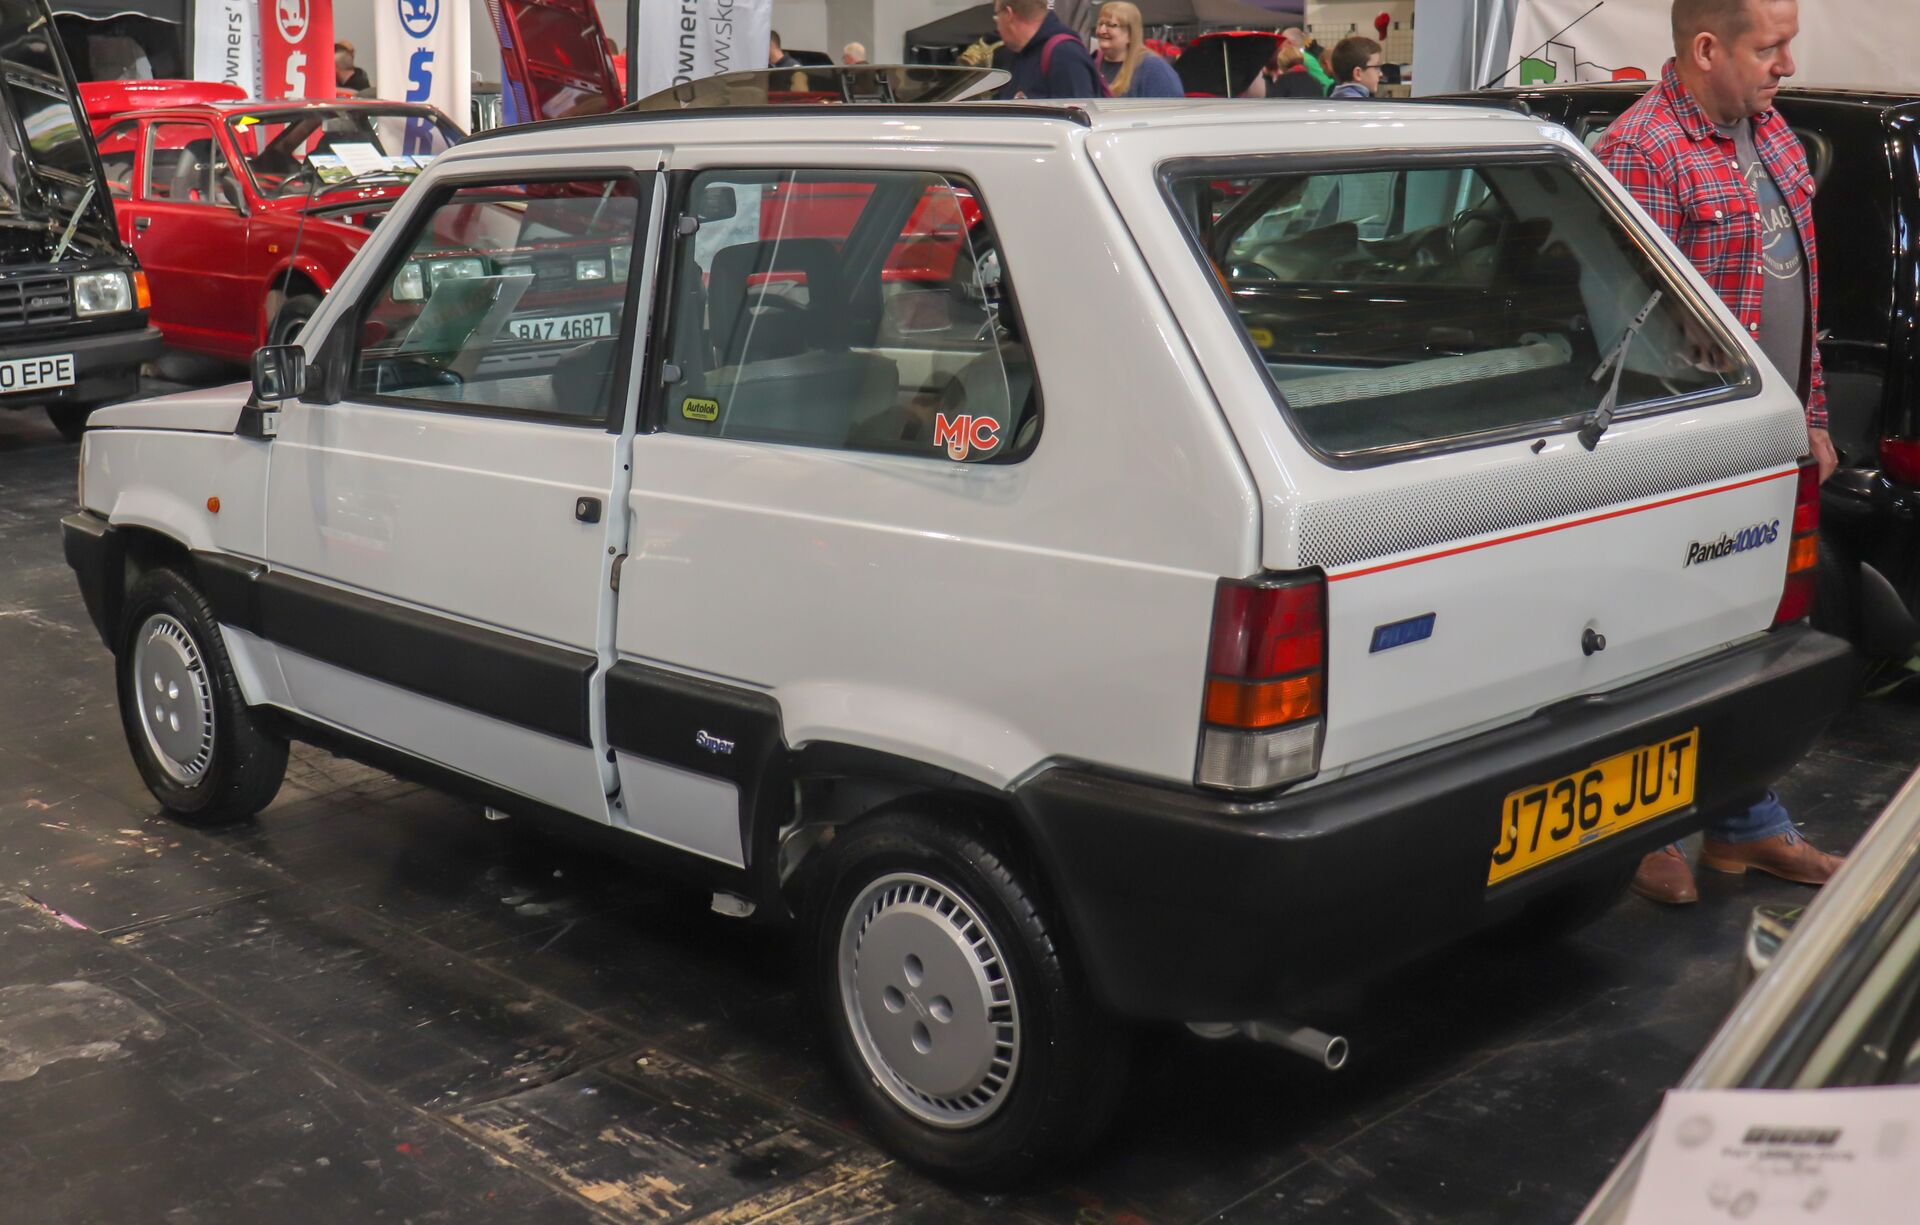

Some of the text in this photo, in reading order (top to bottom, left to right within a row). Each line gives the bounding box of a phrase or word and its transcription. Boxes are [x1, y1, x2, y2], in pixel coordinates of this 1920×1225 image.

[222, 6, 242, 86] wners'
[561, 316, 605, 340] 4687
[22, 358, 71, 386] EPE
[1682, 531, 1735, 568] Panda
[696, 729, 735, 755] Super
[1492, 736, 1692, 866] J736 JUT
